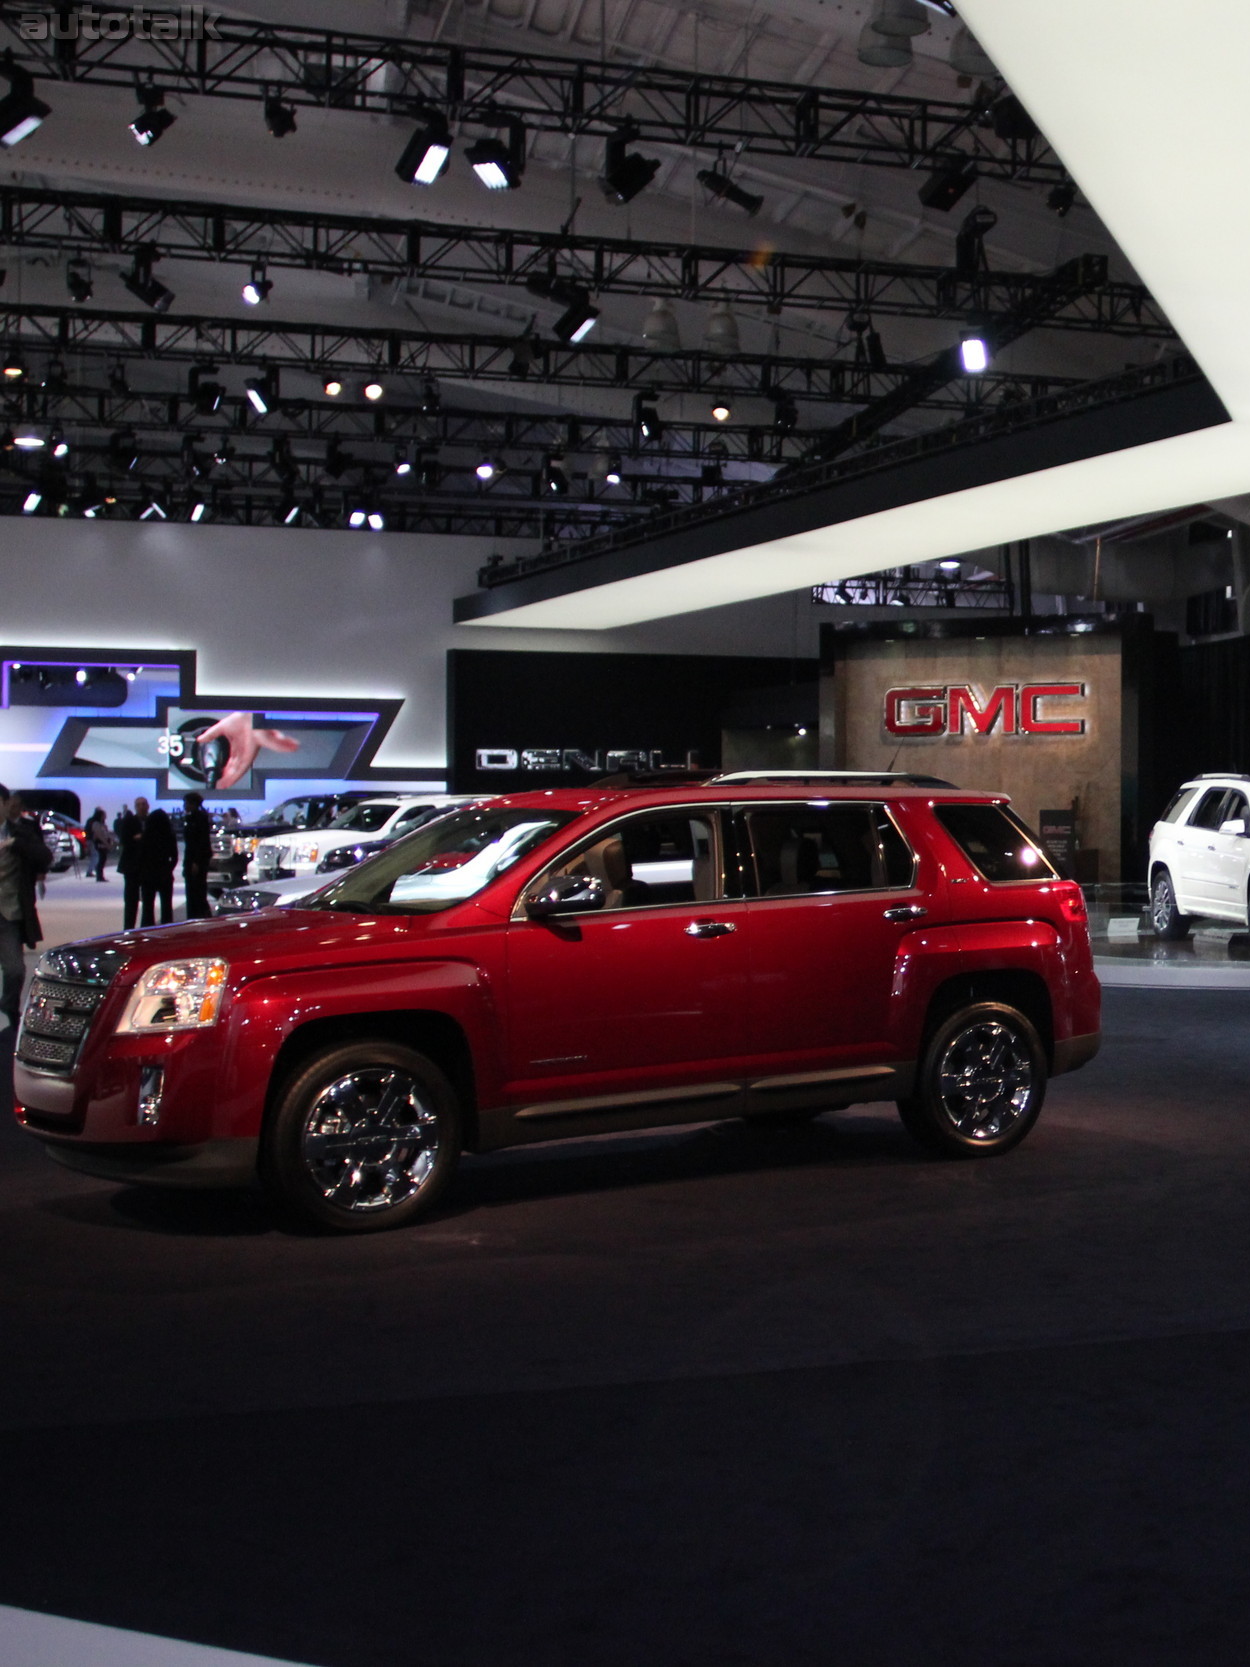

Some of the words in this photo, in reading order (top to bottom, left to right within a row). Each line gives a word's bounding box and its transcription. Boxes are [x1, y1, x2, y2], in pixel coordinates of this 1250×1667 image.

[885, 683, 1085, 736] GMC
[157, 734, 184, 757] 35
[475, 748, 698, 771] DENALI
